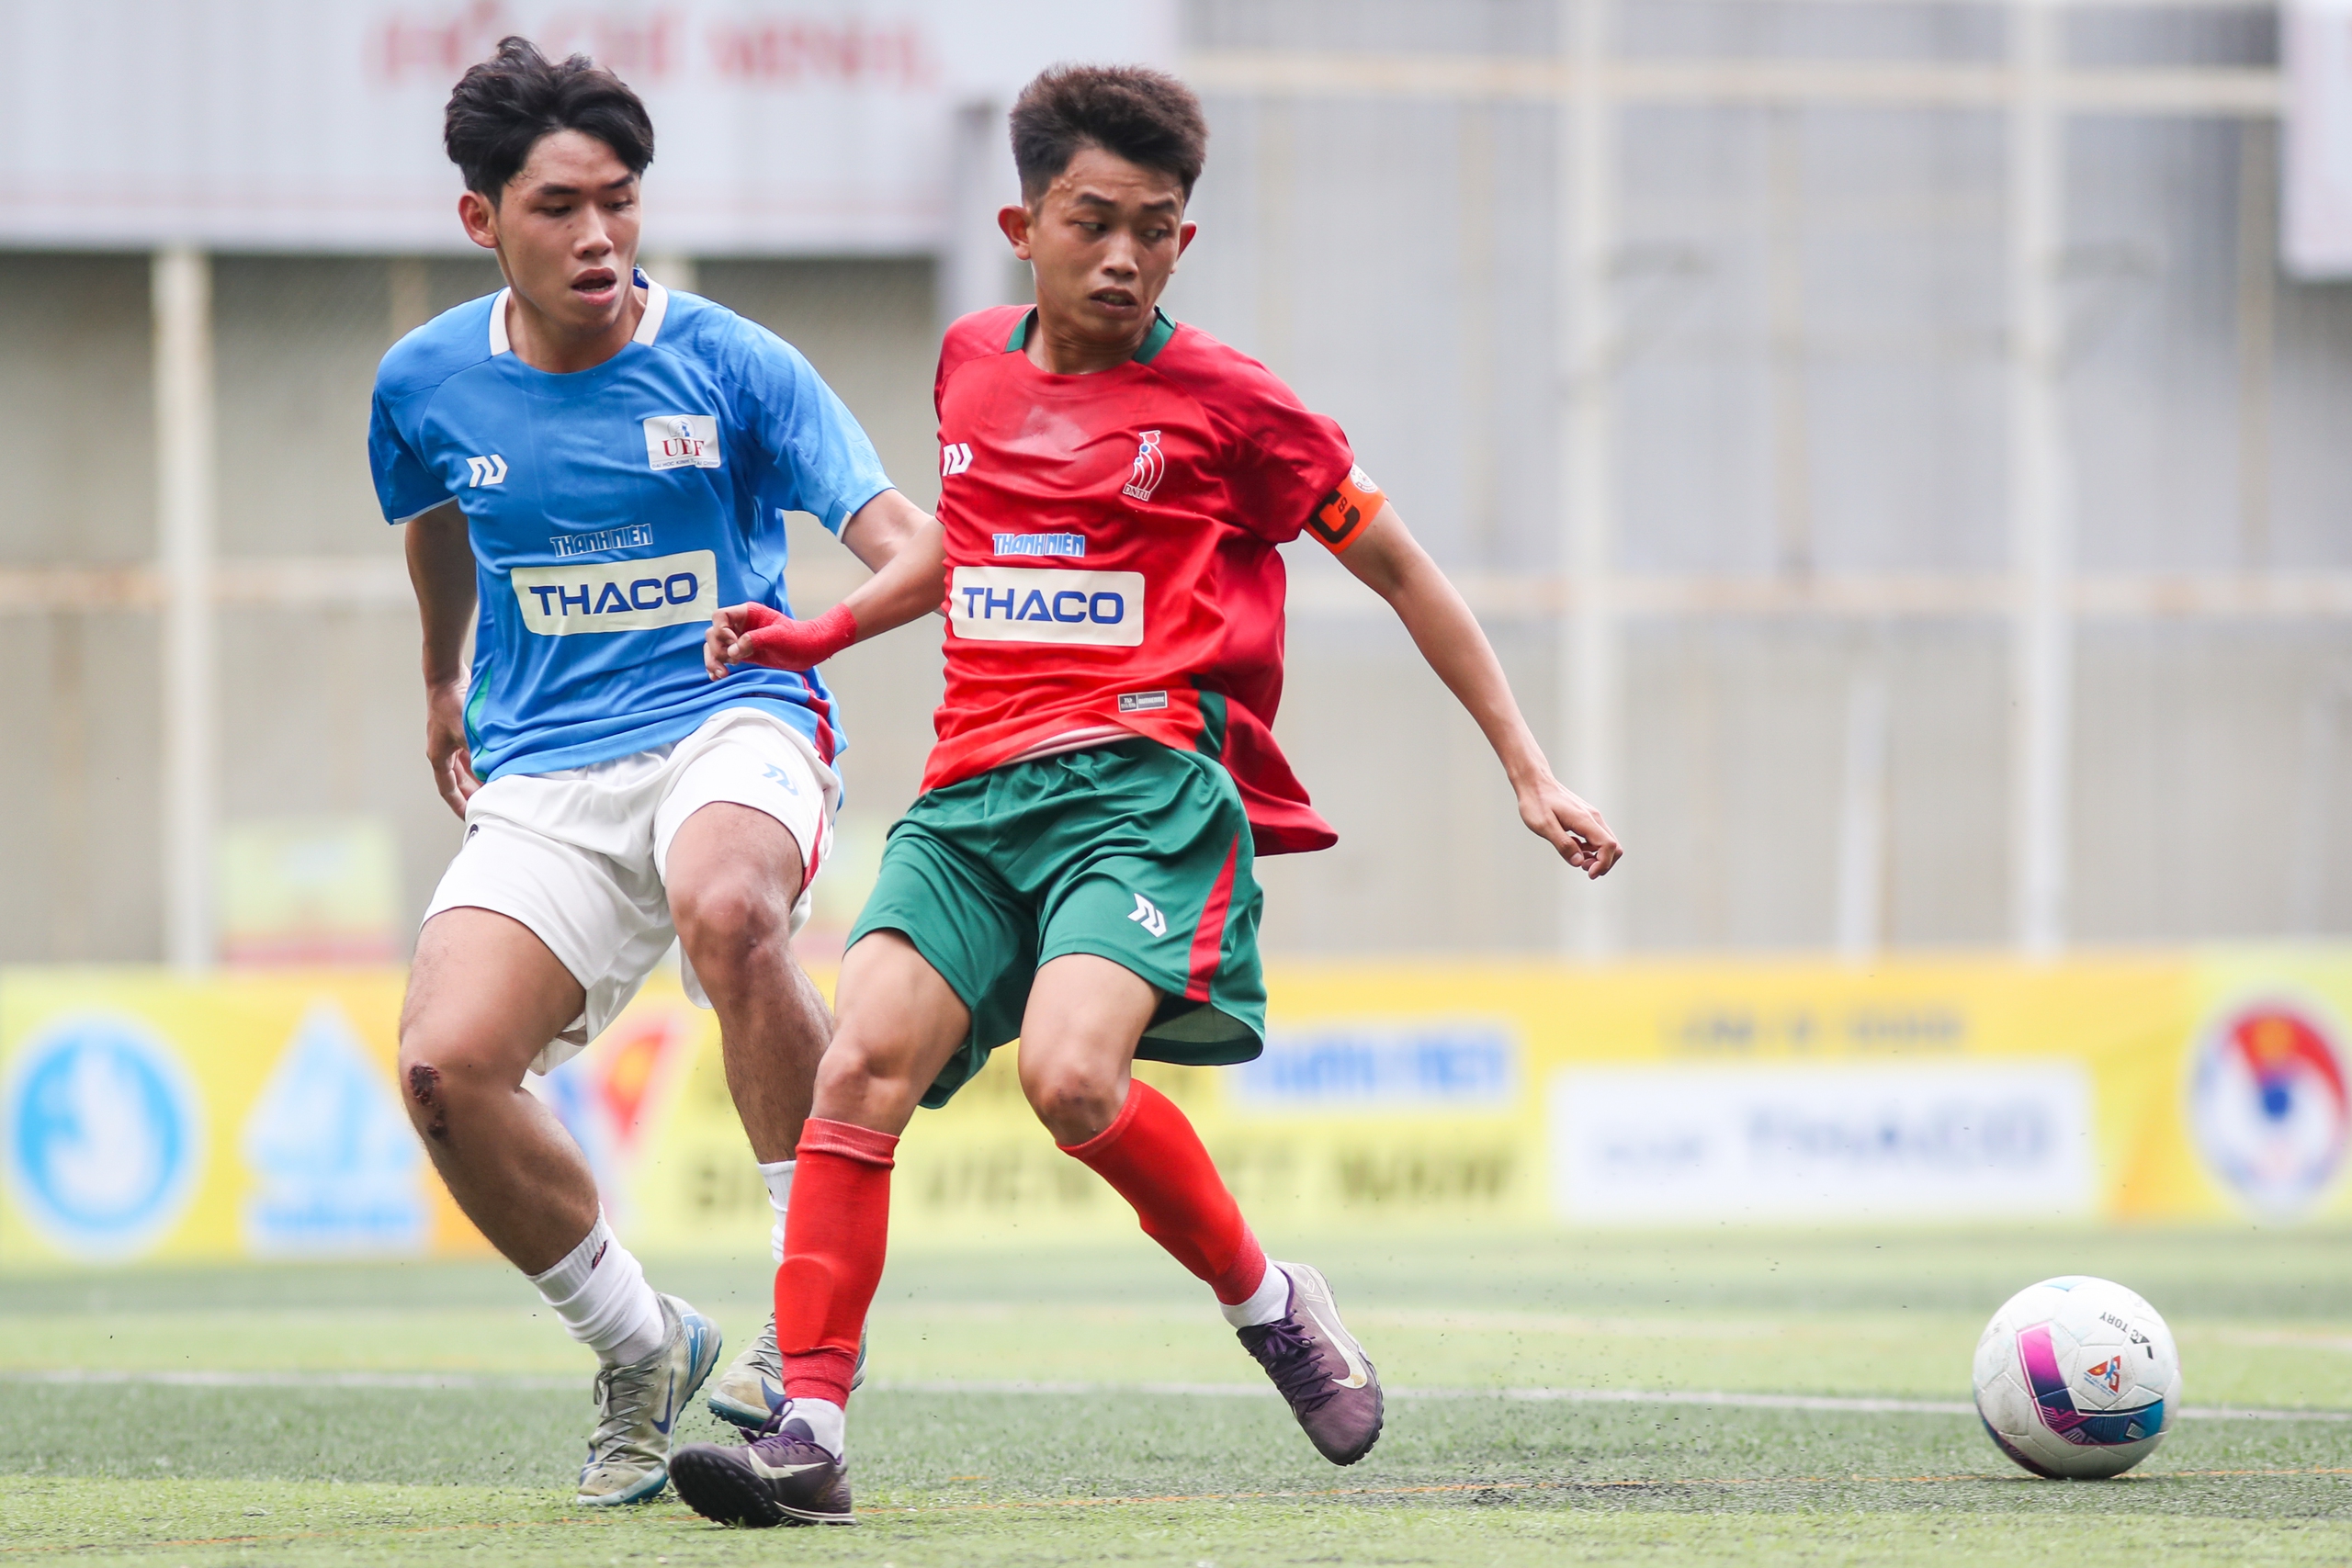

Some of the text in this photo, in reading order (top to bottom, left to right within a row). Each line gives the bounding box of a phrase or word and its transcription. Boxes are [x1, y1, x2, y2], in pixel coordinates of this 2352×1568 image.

[662, 437, 705, 457] UEF
[1124, 485, 1149, 501] DNTU
[1308, 489, 1360, 545] C
[550, 531, 612, 558] THANH
[992, 532, 1085, 558] THANH NIÊN
[528, 572, 698, 616] THACO
[962, 587, 1124, 625] THACO
